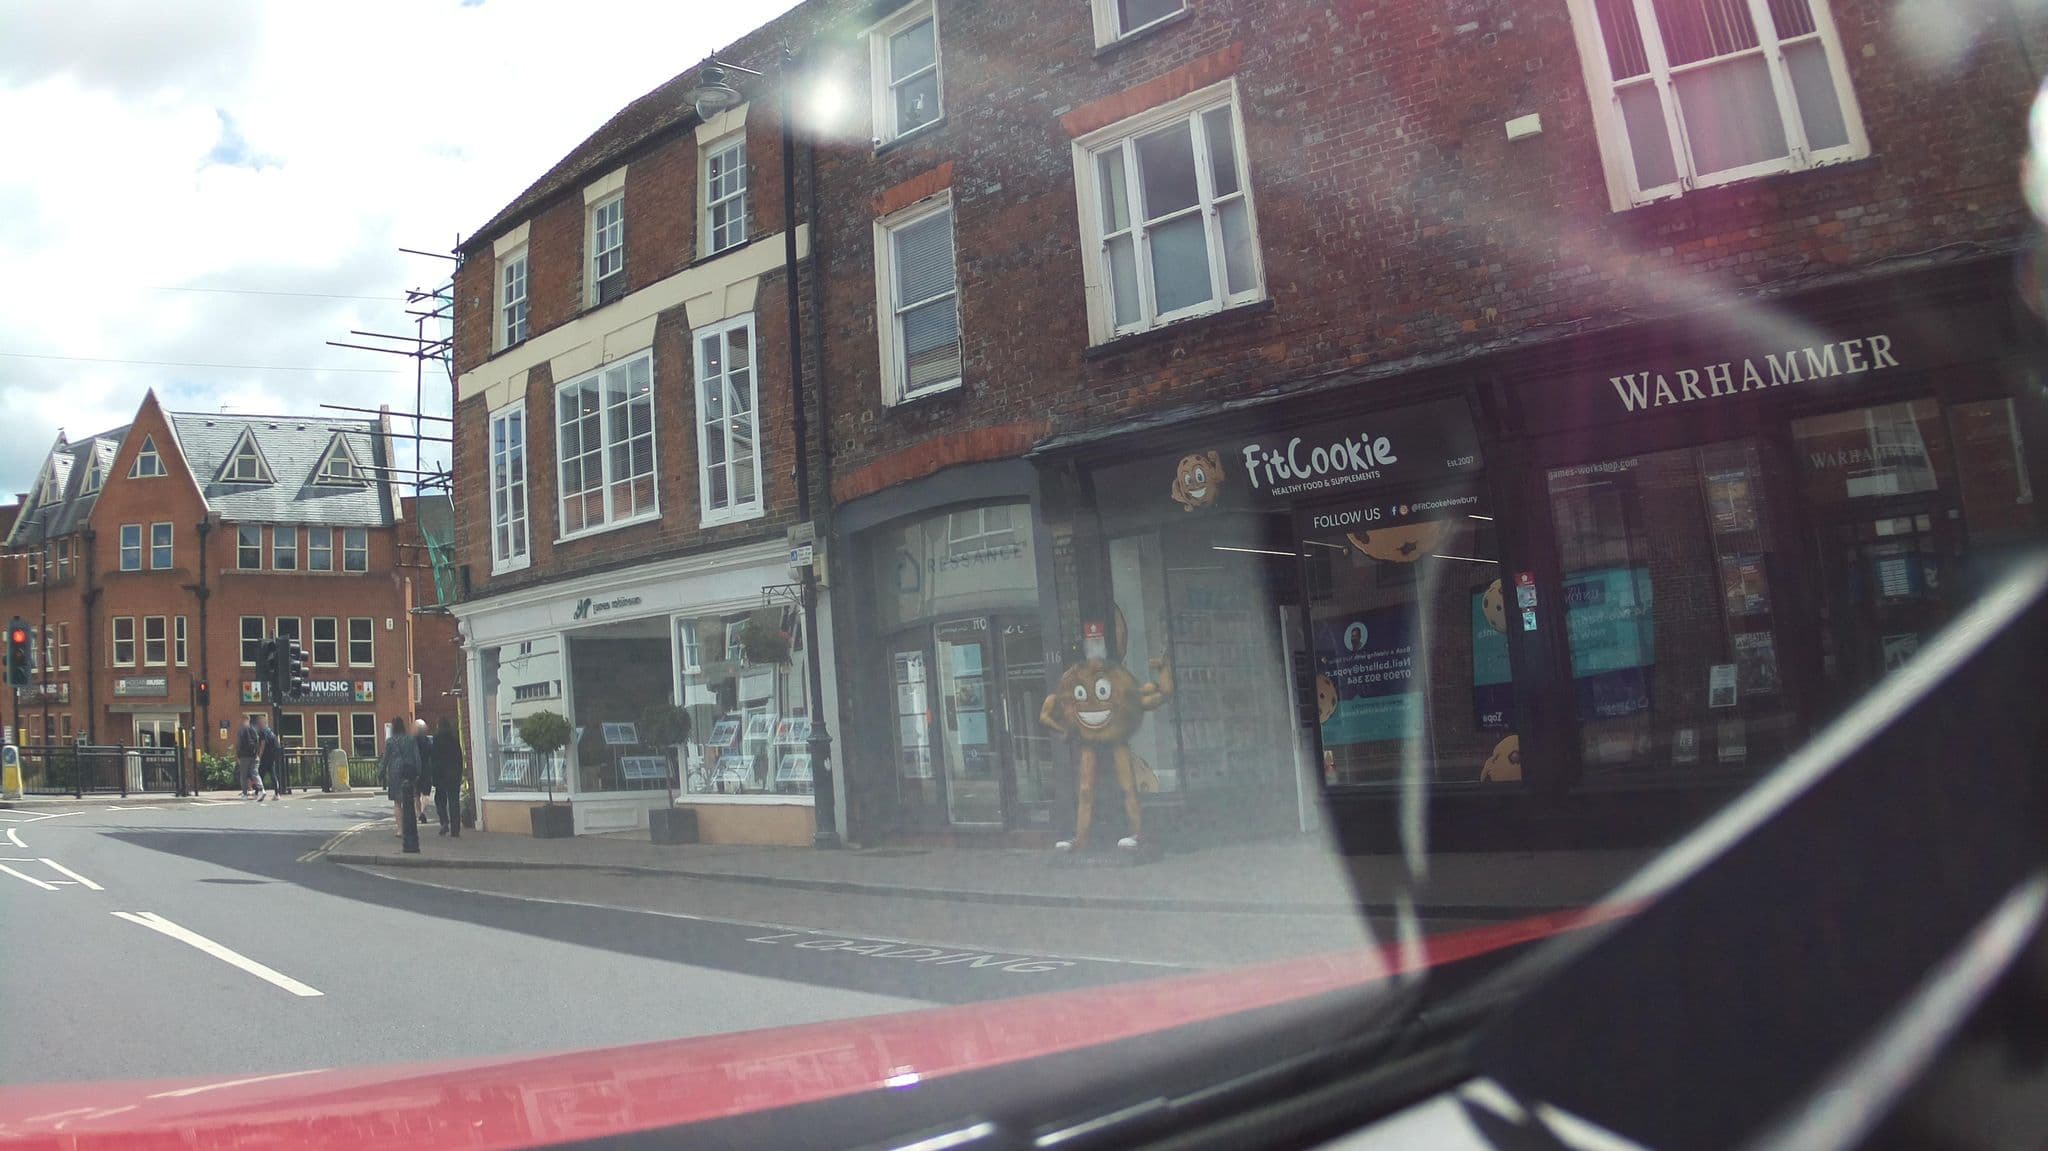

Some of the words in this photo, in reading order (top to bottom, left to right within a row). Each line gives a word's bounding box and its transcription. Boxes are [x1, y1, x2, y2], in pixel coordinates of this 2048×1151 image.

[1610, 334, 1900, 413] WARHAMMER
[1242, 432, 1398, 489] FitCookie
[1547, 458, 1639, 480] games-workshop.com
[1271, 484, 1302, 497] HEALTHY
[1303, 480, 1323, 490] FOOD
[1324, 479, 1331, 488] &
[1331, 470, 1381, 486] SUPPLEMENTS
[1313, 510, 1362, 529] FOLLOW
[1364, 507, 1382, 521] US
[311, 681, 349, 692] MUSIC
[745, 932, 1077, 974] LOADING
